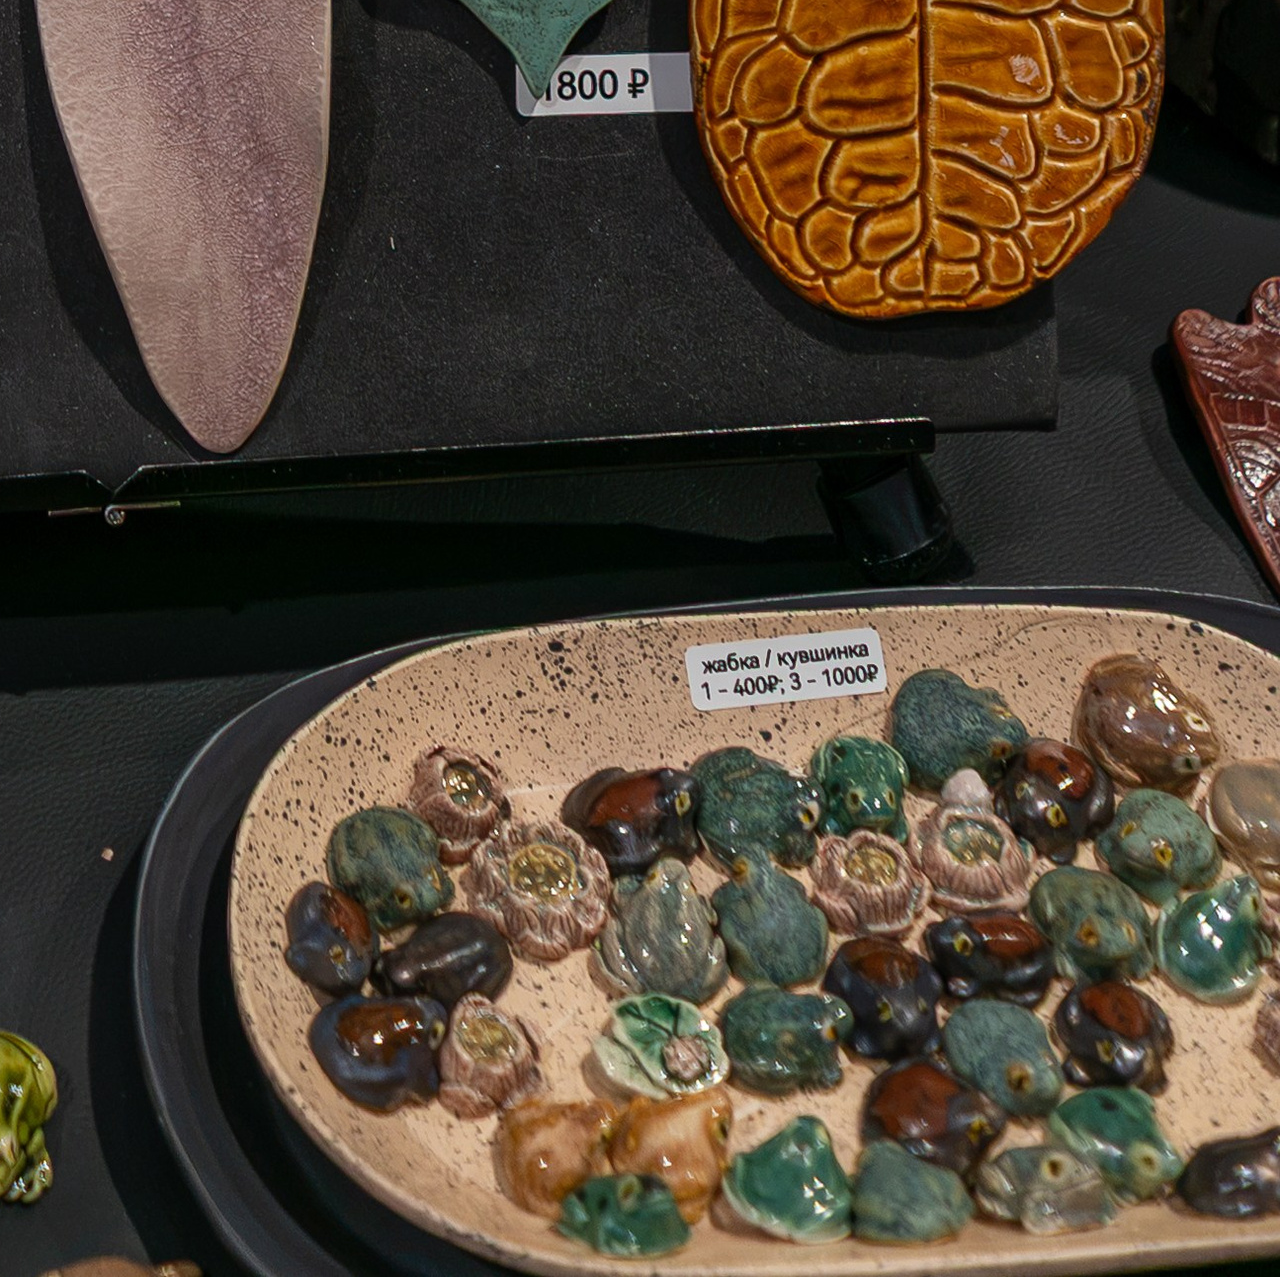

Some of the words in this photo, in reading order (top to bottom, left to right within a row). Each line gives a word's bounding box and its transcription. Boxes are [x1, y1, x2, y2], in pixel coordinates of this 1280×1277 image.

[702, 653, 760, 674] жабка
[764, 649, 772, 667] /
[777, 643, 869, 670] кувшинка
[700, 681, 711, 700] 1
[790, 672, 802, 691] 3
[822, 663, 879, 687] 1000₽
